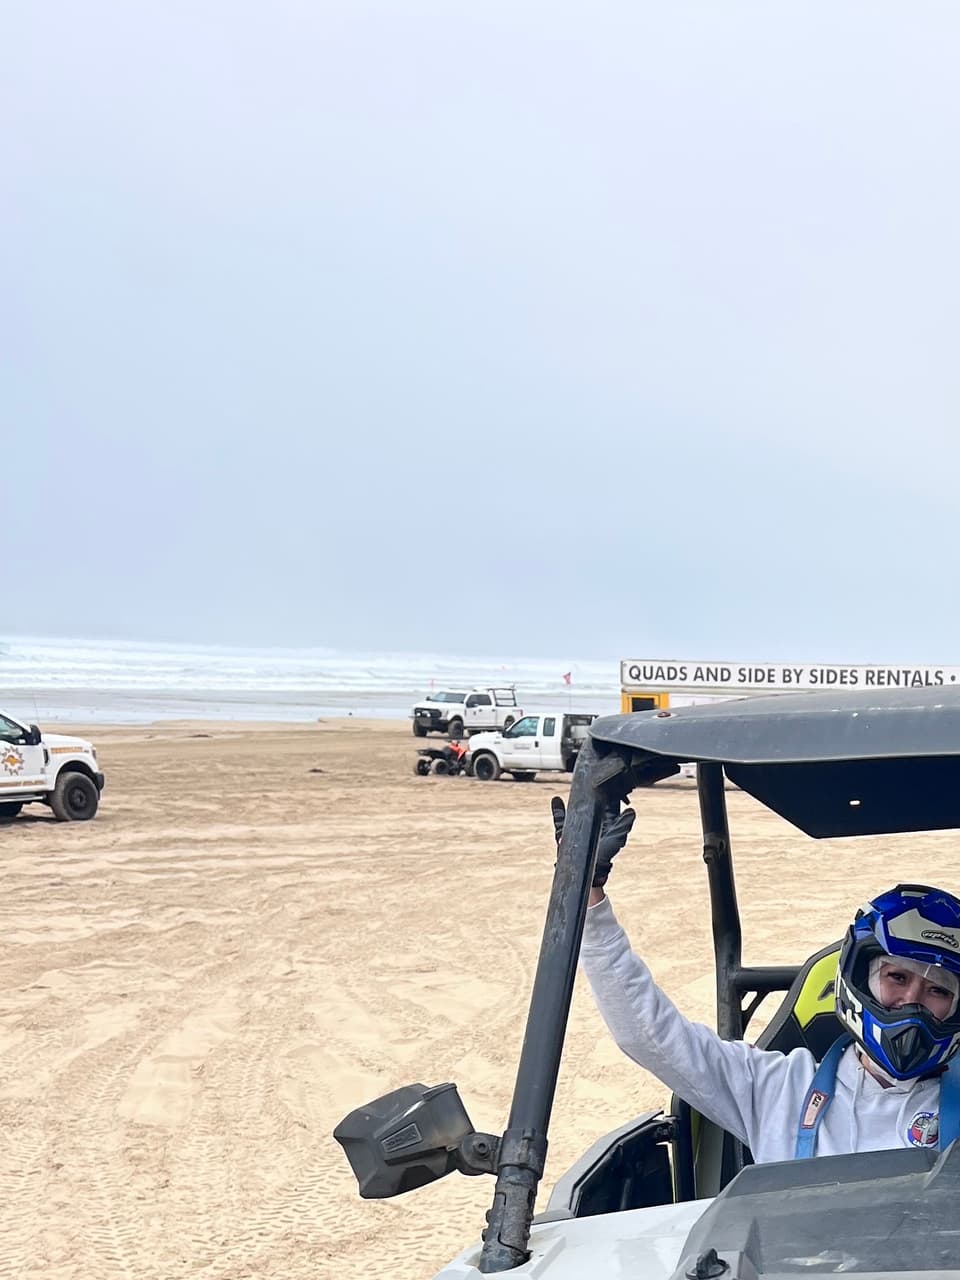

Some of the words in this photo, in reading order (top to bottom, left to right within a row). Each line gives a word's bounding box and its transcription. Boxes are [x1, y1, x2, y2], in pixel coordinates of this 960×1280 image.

[628, 665, 688, 681] QUADS
[693, 666, 732, 682] AND
[738, 667, 776, 683] SIDE
[782, 668, 804, 684] BY
[809, 669, 859, 685] SIDES
[865, 670, 944, 688] RENTALS
